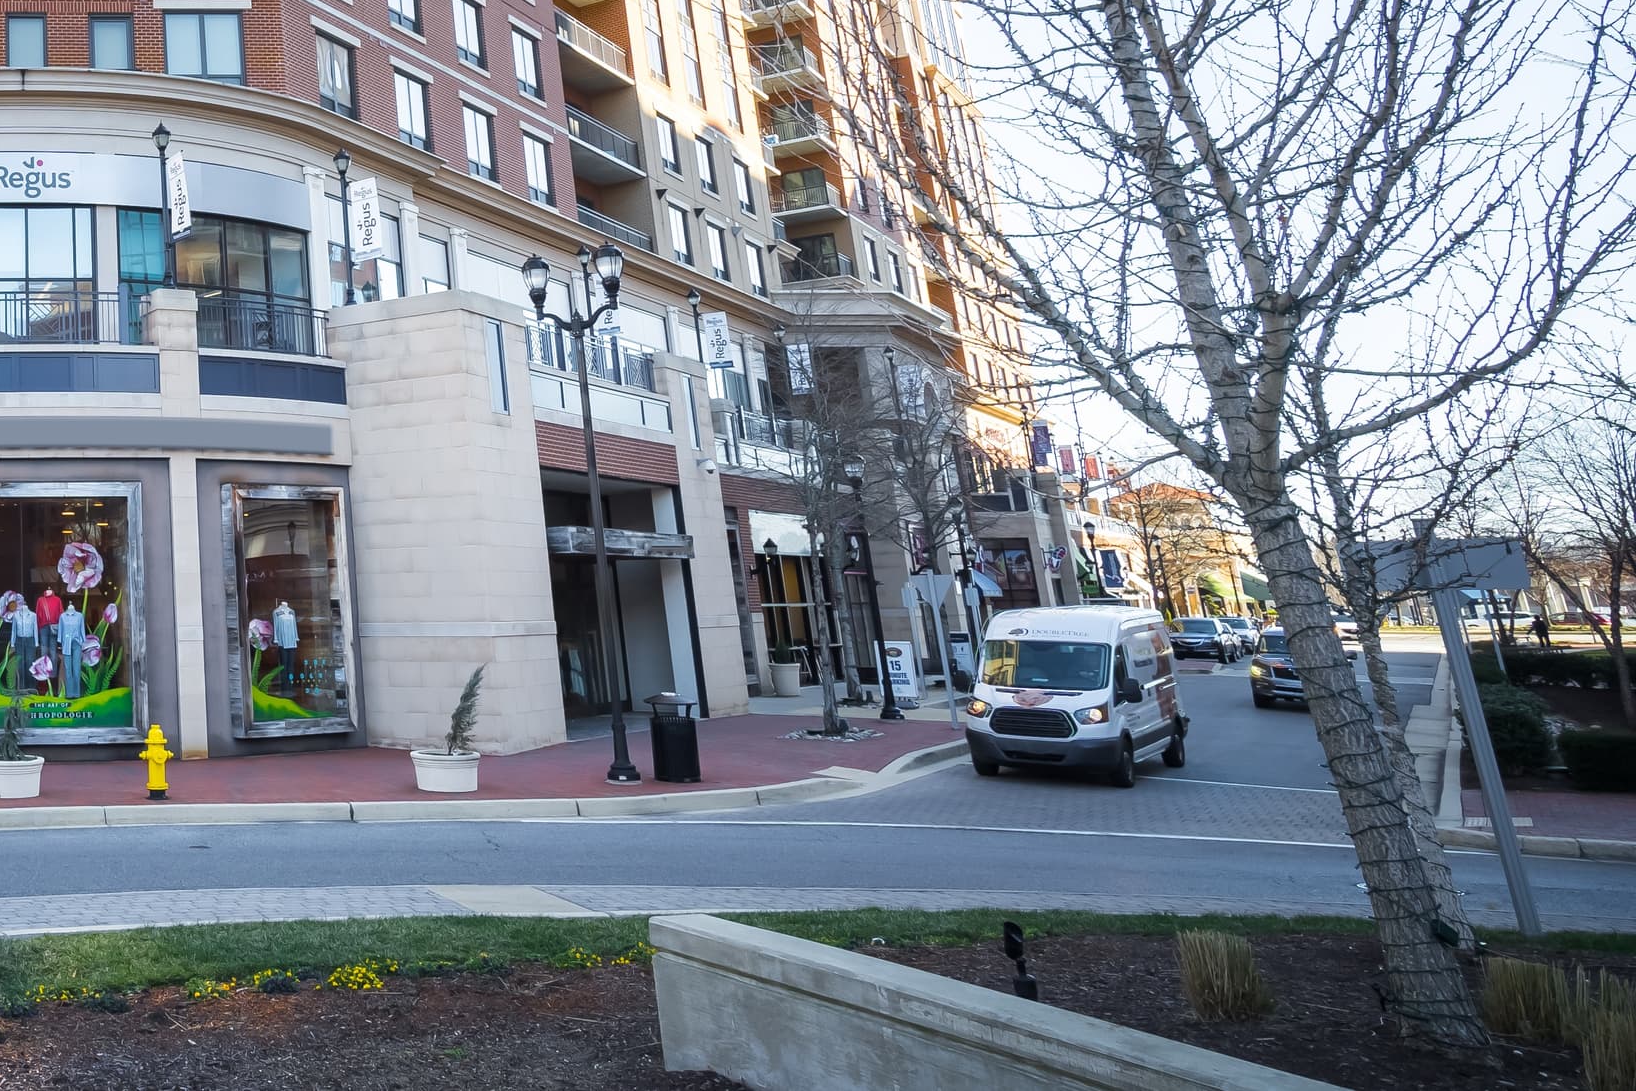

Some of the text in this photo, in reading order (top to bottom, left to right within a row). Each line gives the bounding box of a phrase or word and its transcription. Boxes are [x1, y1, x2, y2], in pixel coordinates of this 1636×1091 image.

[176, 178, 187, 226] Regus
[363, 202, 377, 247] Regus
[715, 328, 727, 359] Regus
[889, 660, 901, 671] 15
[30, 711, 93, 719] HROPOLOGIE
